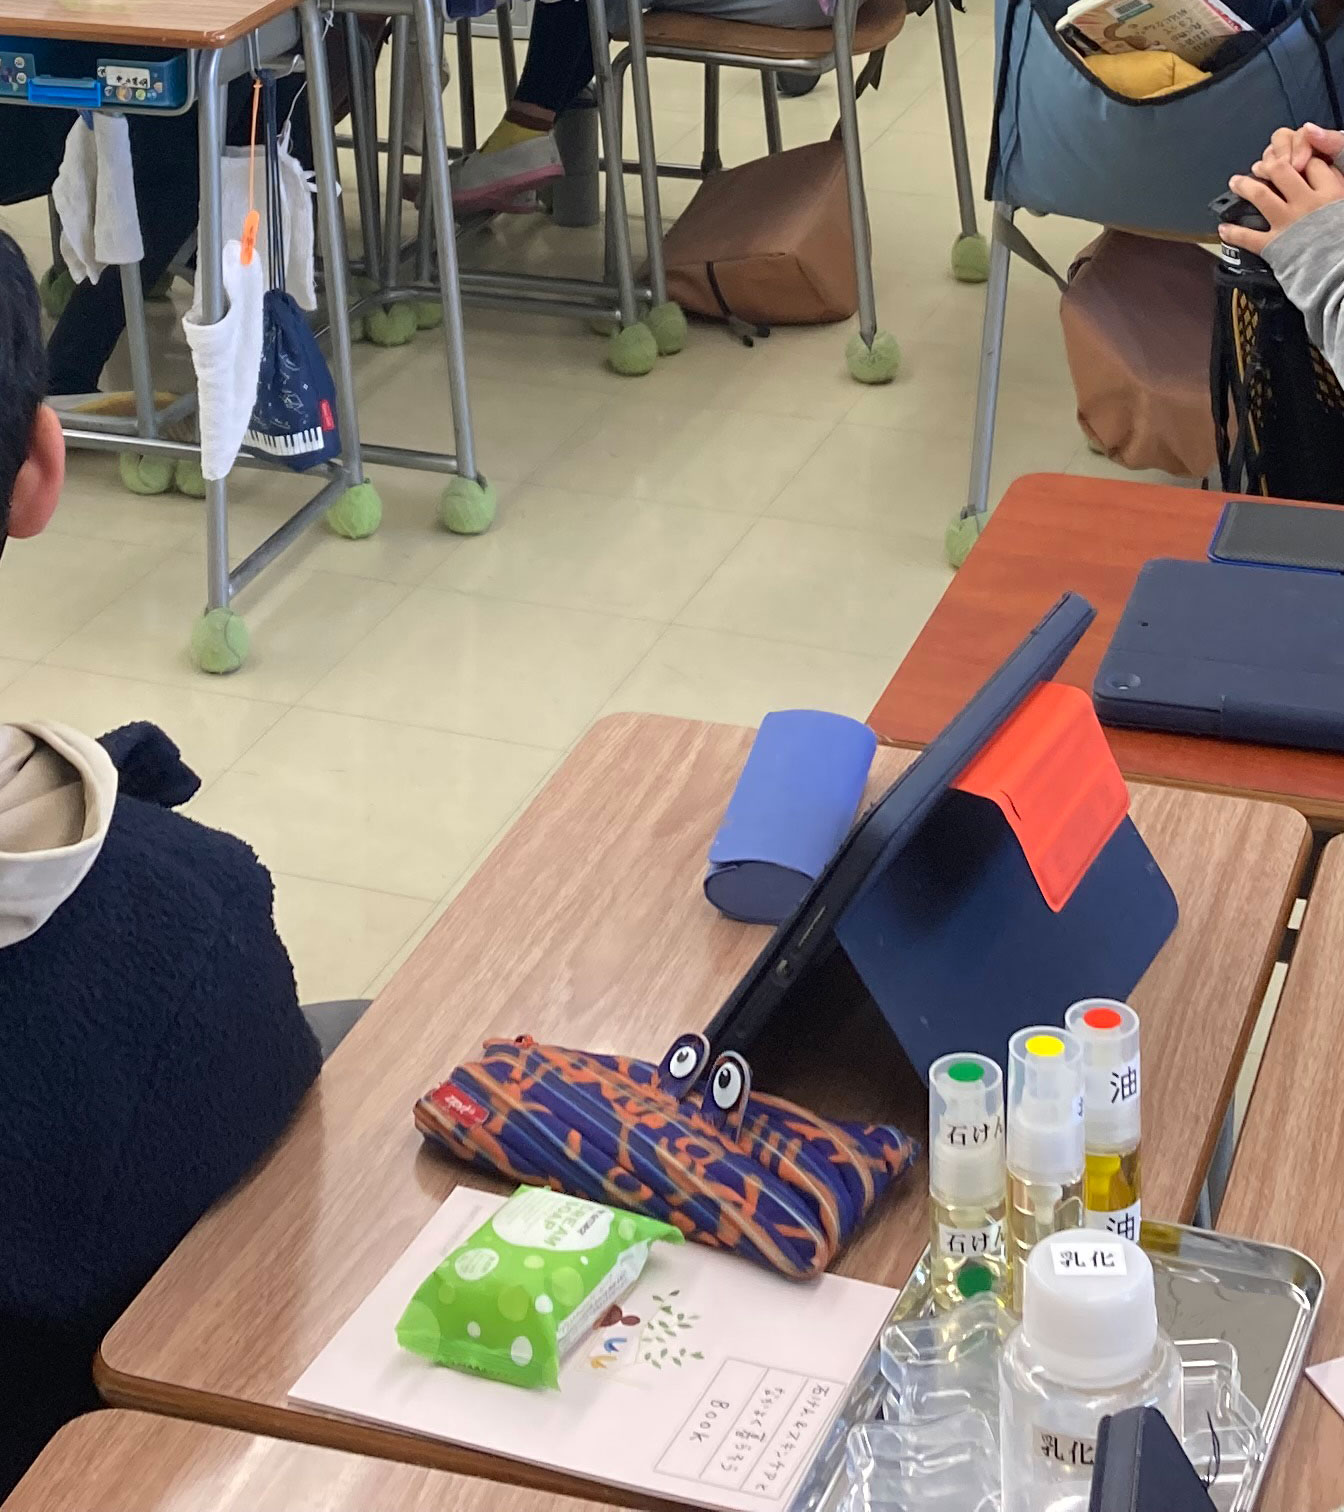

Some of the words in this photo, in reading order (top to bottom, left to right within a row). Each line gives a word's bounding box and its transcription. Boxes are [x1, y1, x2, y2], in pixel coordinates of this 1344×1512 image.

[1109, 1065, 1138, 1104] 油
[1059, 1250, 1116, 1269] 乳化
[1040, 1433, 1096, 1466] 乳化
